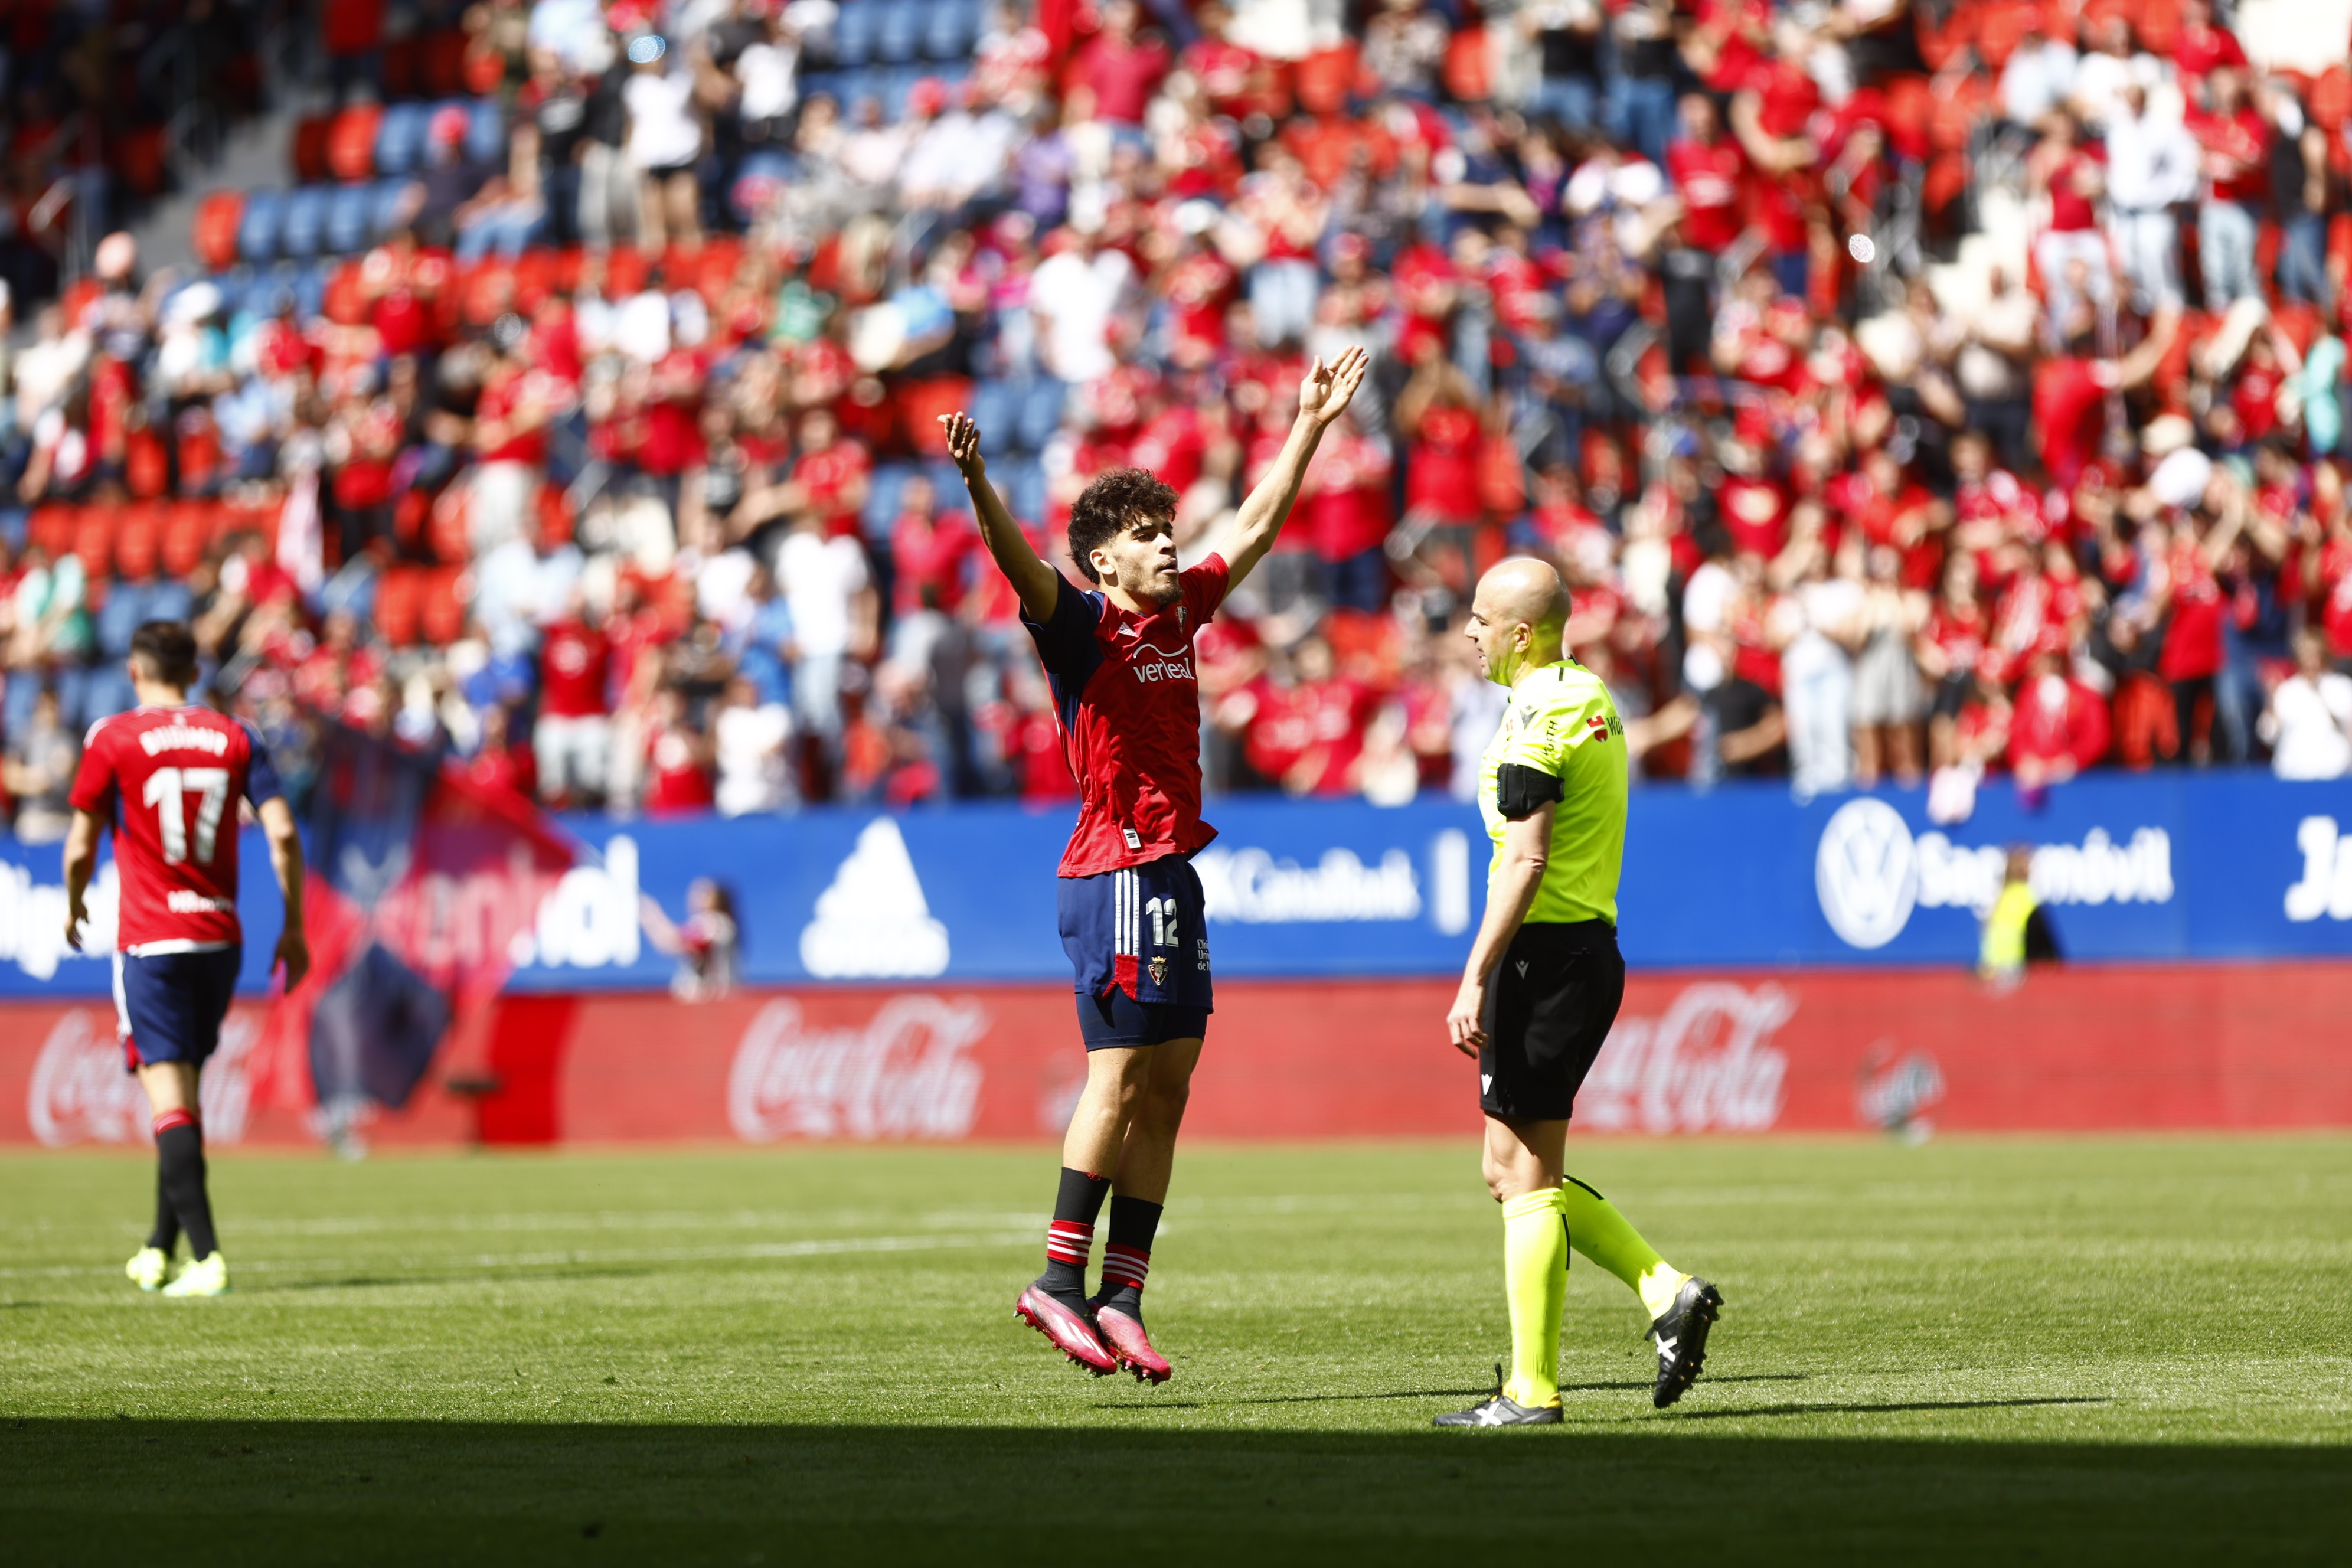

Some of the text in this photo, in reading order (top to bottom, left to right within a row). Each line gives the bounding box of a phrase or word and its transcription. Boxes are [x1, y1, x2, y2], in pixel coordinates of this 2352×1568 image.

[1133, 656, 1195, 683] verleal
[143, 767, 230, 865] 17
[1145, 897, 1179, 948] 12
[1198, 961, 1206, 971] de
[726, 994, 989, 1144] Coca-Cola
